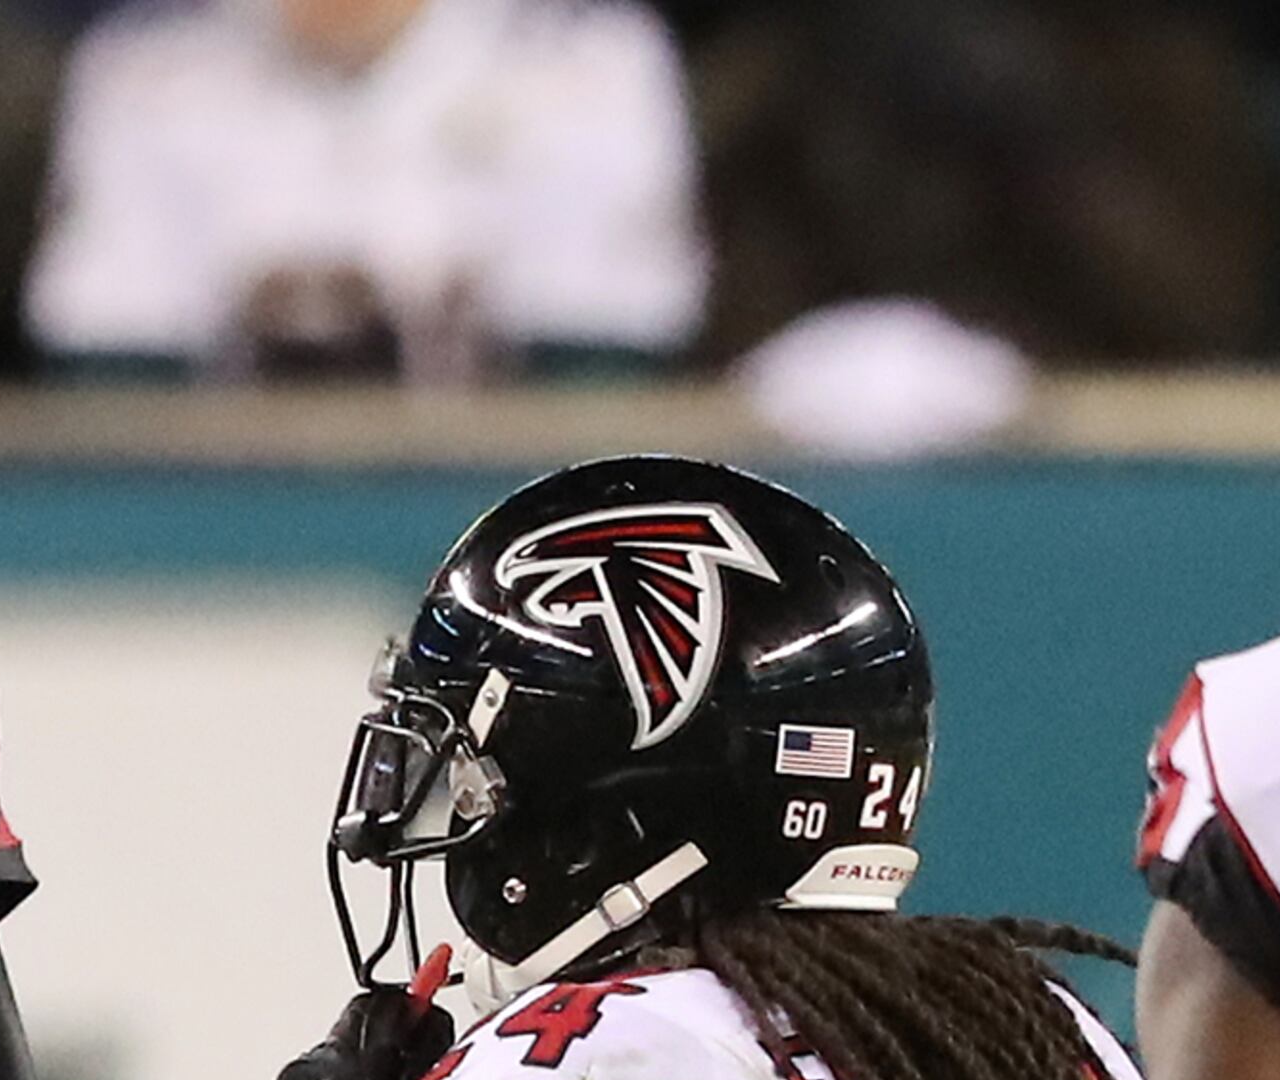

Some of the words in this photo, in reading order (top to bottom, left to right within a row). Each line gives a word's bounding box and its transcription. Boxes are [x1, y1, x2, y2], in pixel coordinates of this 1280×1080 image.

[859, 763, 922, 832] 24
[782, 799, 827, 840] 60
[830, 864, 917, 882] FALCO
